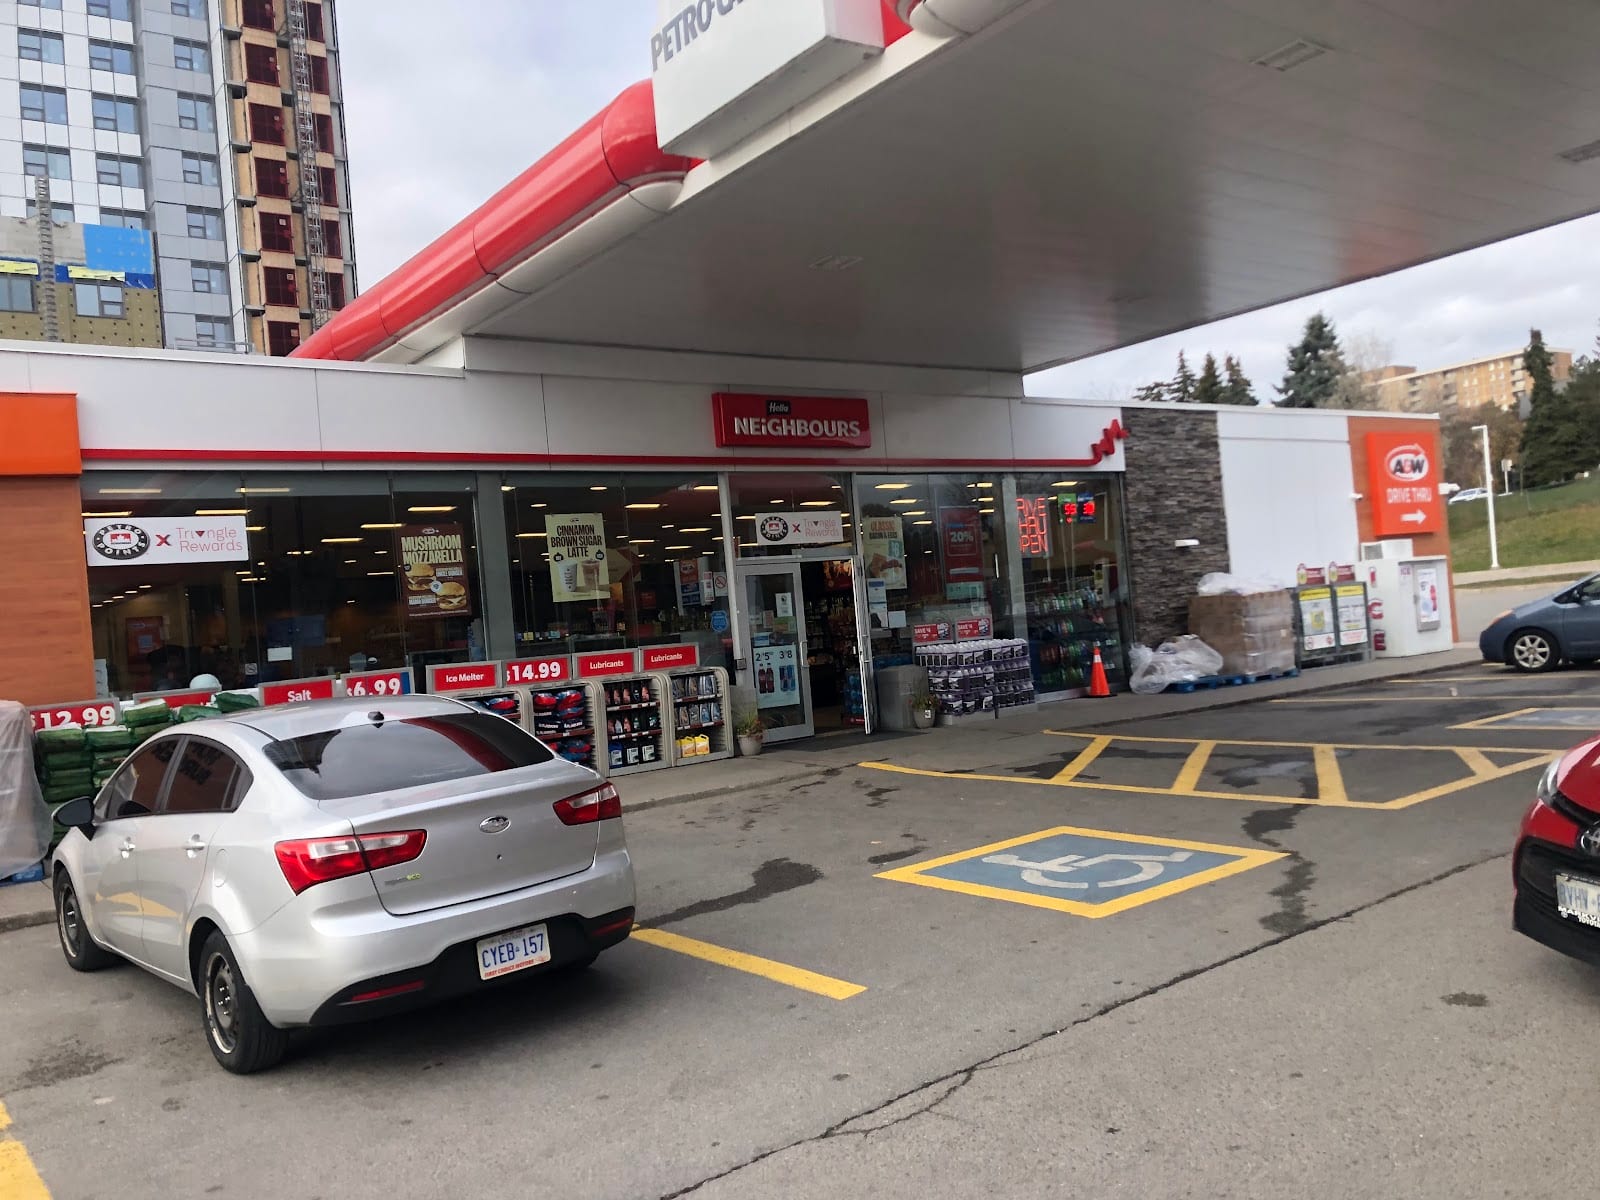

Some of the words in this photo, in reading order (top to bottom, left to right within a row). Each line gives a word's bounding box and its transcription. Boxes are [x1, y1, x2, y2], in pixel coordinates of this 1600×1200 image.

[651, 0, 743, 72] PETRO-
[1387, 487, 1411, 503] DRIVE
[1411, 487, 1432, 503] THRU
[1016, 497, 1047, 517] RIVE
[98, 524, 142, 536] PETRO
[556, 525, 595, 536] CINNAMON
[1018, 515, 1048, 535] HRU
[401, 535, 461, 552] MUSHROOM
[551, 536, 578, 548] BROWN
[579, 535, 602, 547] SUGAR
[950, 531, 974, 543] 20%
[96, 542, 146, 556] POINTS
[179, 539, 243, 553] Rewards
[1020, 534, 1049, 554] PEN
[402, 549, 463, 565] MOZZARELLA
[567, 546, 588, 558] LATTE
[651, 653, 682, 662] Lubricants
[590, 660, 624, 669] Lubricants
[459, 673, 484, 682] Melter
[287, 689, 312, 702] Salt
